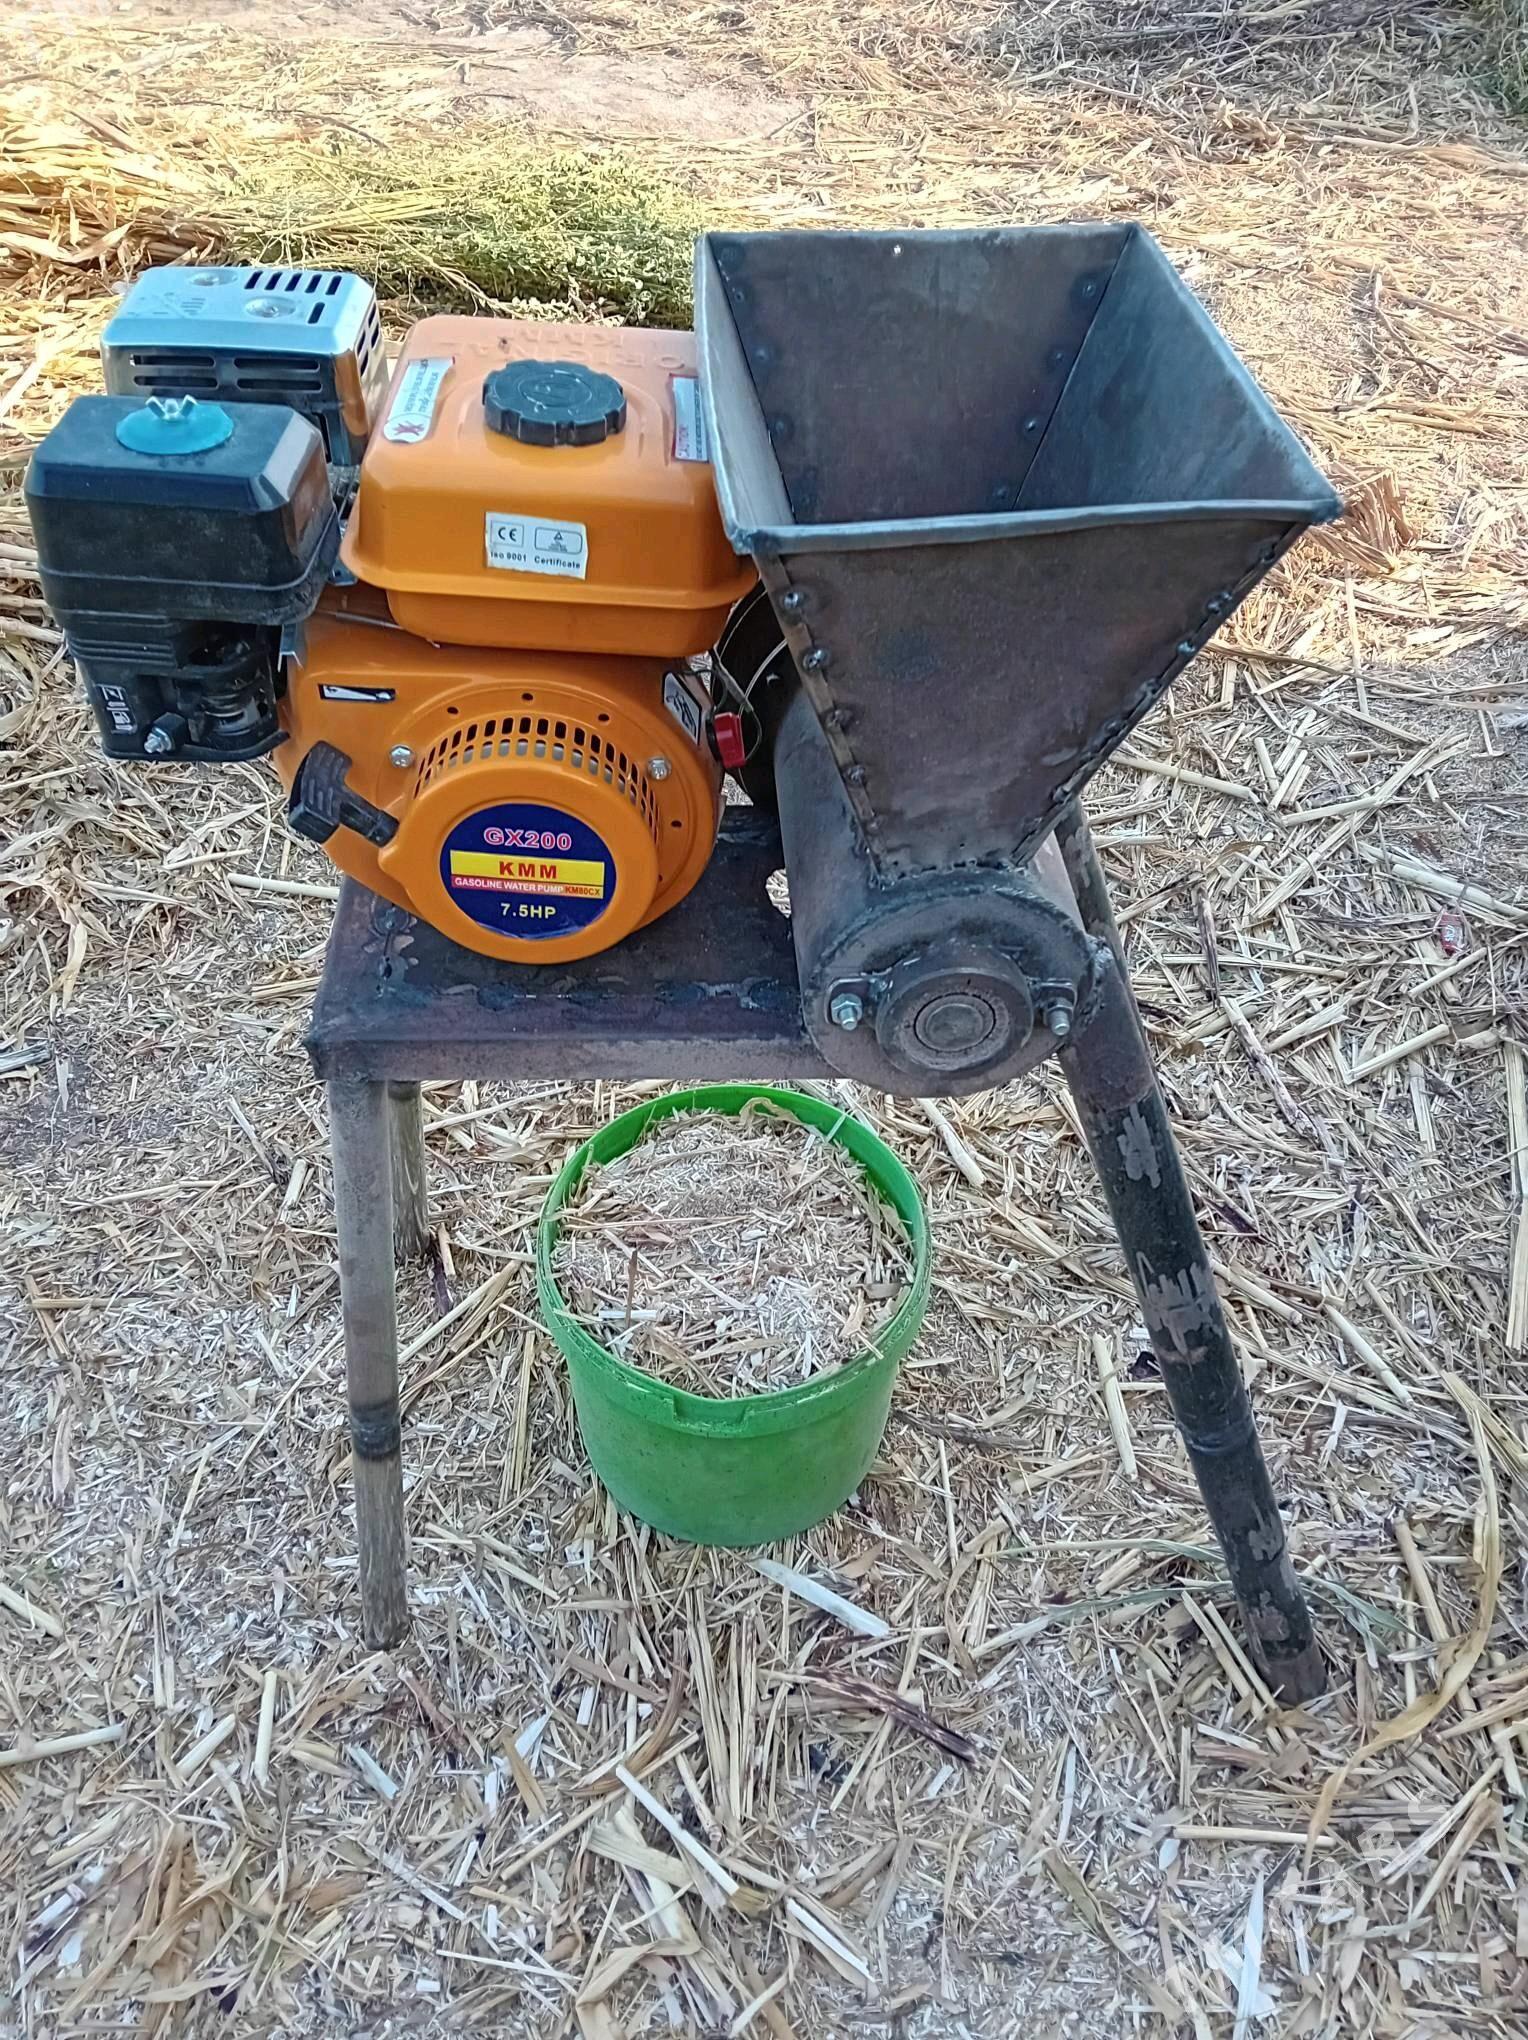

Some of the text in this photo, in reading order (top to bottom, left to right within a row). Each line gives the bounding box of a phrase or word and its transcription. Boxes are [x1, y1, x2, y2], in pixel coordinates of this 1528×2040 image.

[497, 526, 517, 542] CE
[506, 551, 527, 562] 9001
[534, 555, 581, 569] Certificate
[483, 827, 572, 851] GX200
[499, 860, 557, 879] KMM
[454, 877, 502, 890] GASOLINE
[503, 880, 537, 893] WATER
[537, 884, 564, 894] PUMP
[500, 902, 557, 920] 7.5HP
